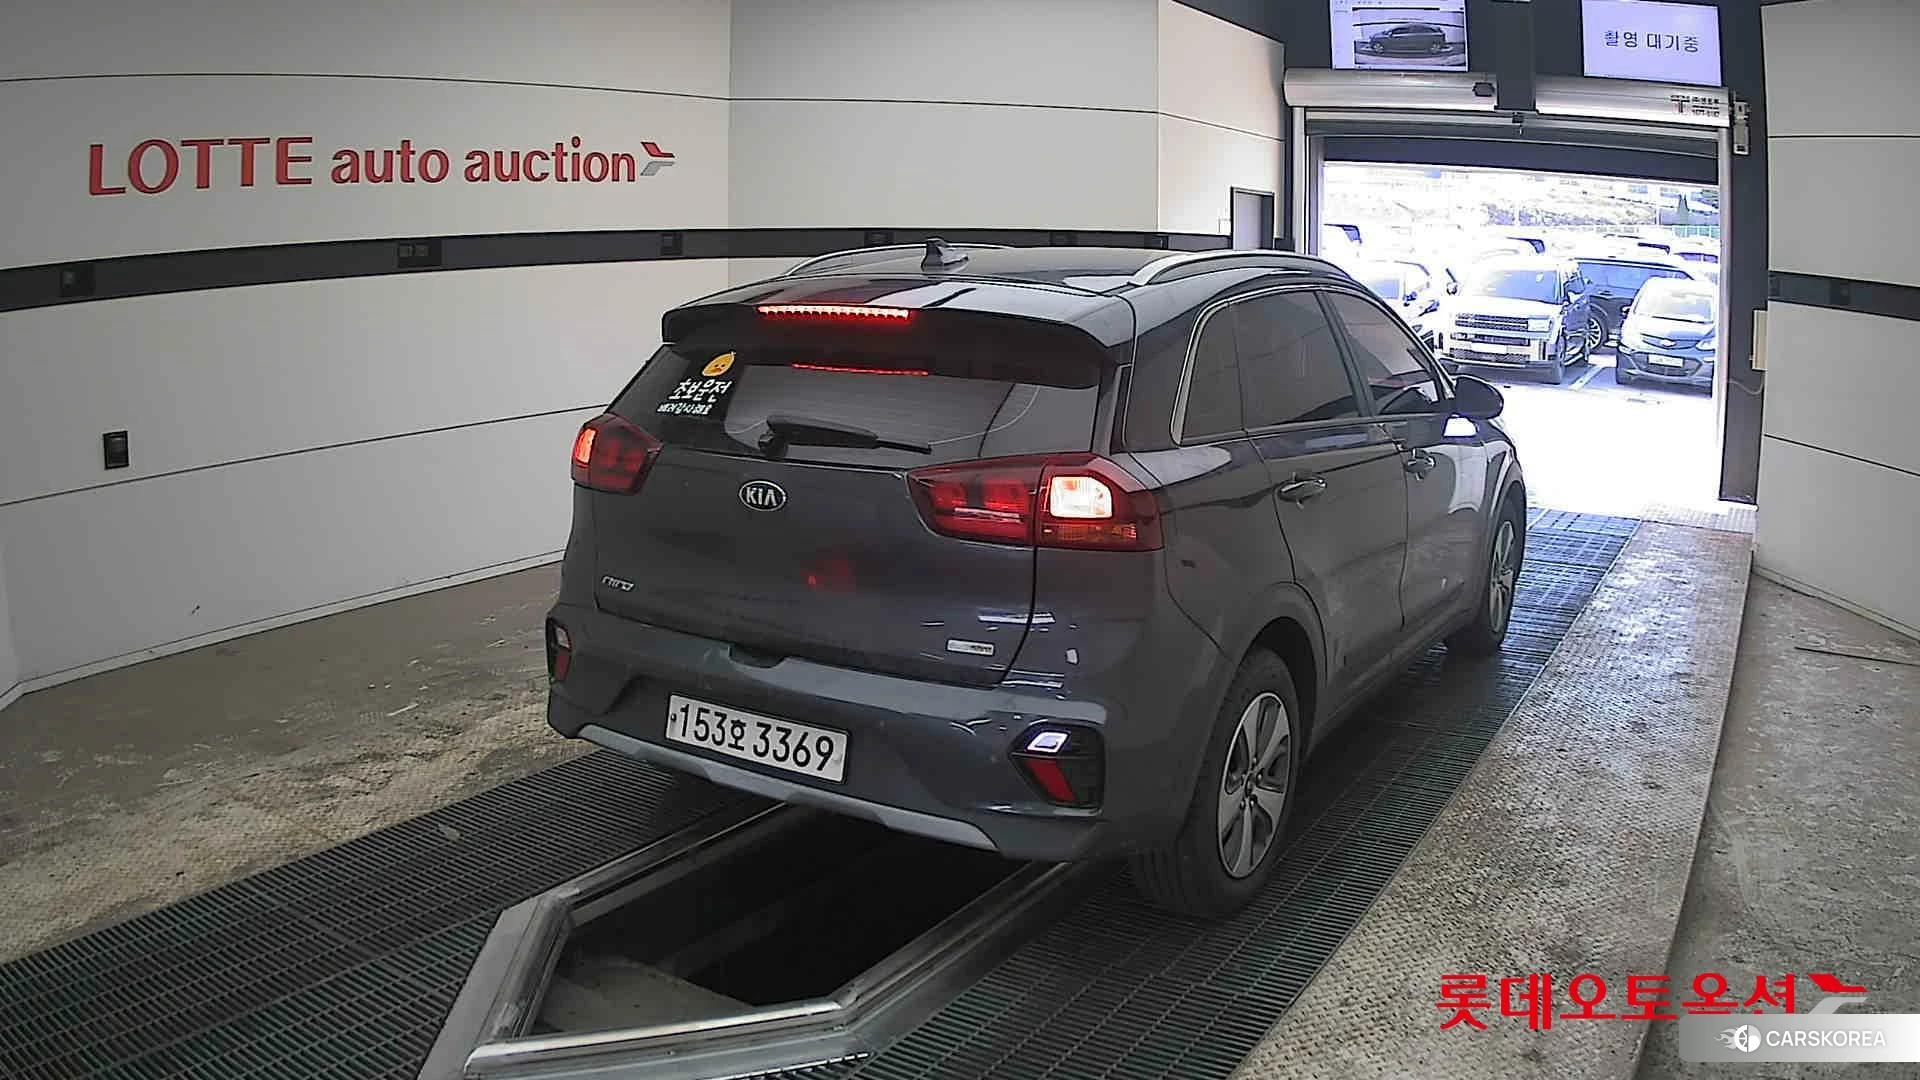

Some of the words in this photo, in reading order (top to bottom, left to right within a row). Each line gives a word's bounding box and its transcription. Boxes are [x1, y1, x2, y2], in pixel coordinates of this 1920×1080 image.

[1646, 33, 1698, 53] 대기중
[88, 136, 313, 196] LOTTE
[330, 139, 450, 184] auto
[463, 136, 636, 183] auction
[668, 378, 733, 403] 초보운전
[746, 486, 777, 506] KIA
[680, 703, 746, 751] 153호
[752, 721, 834, 771] 3369
